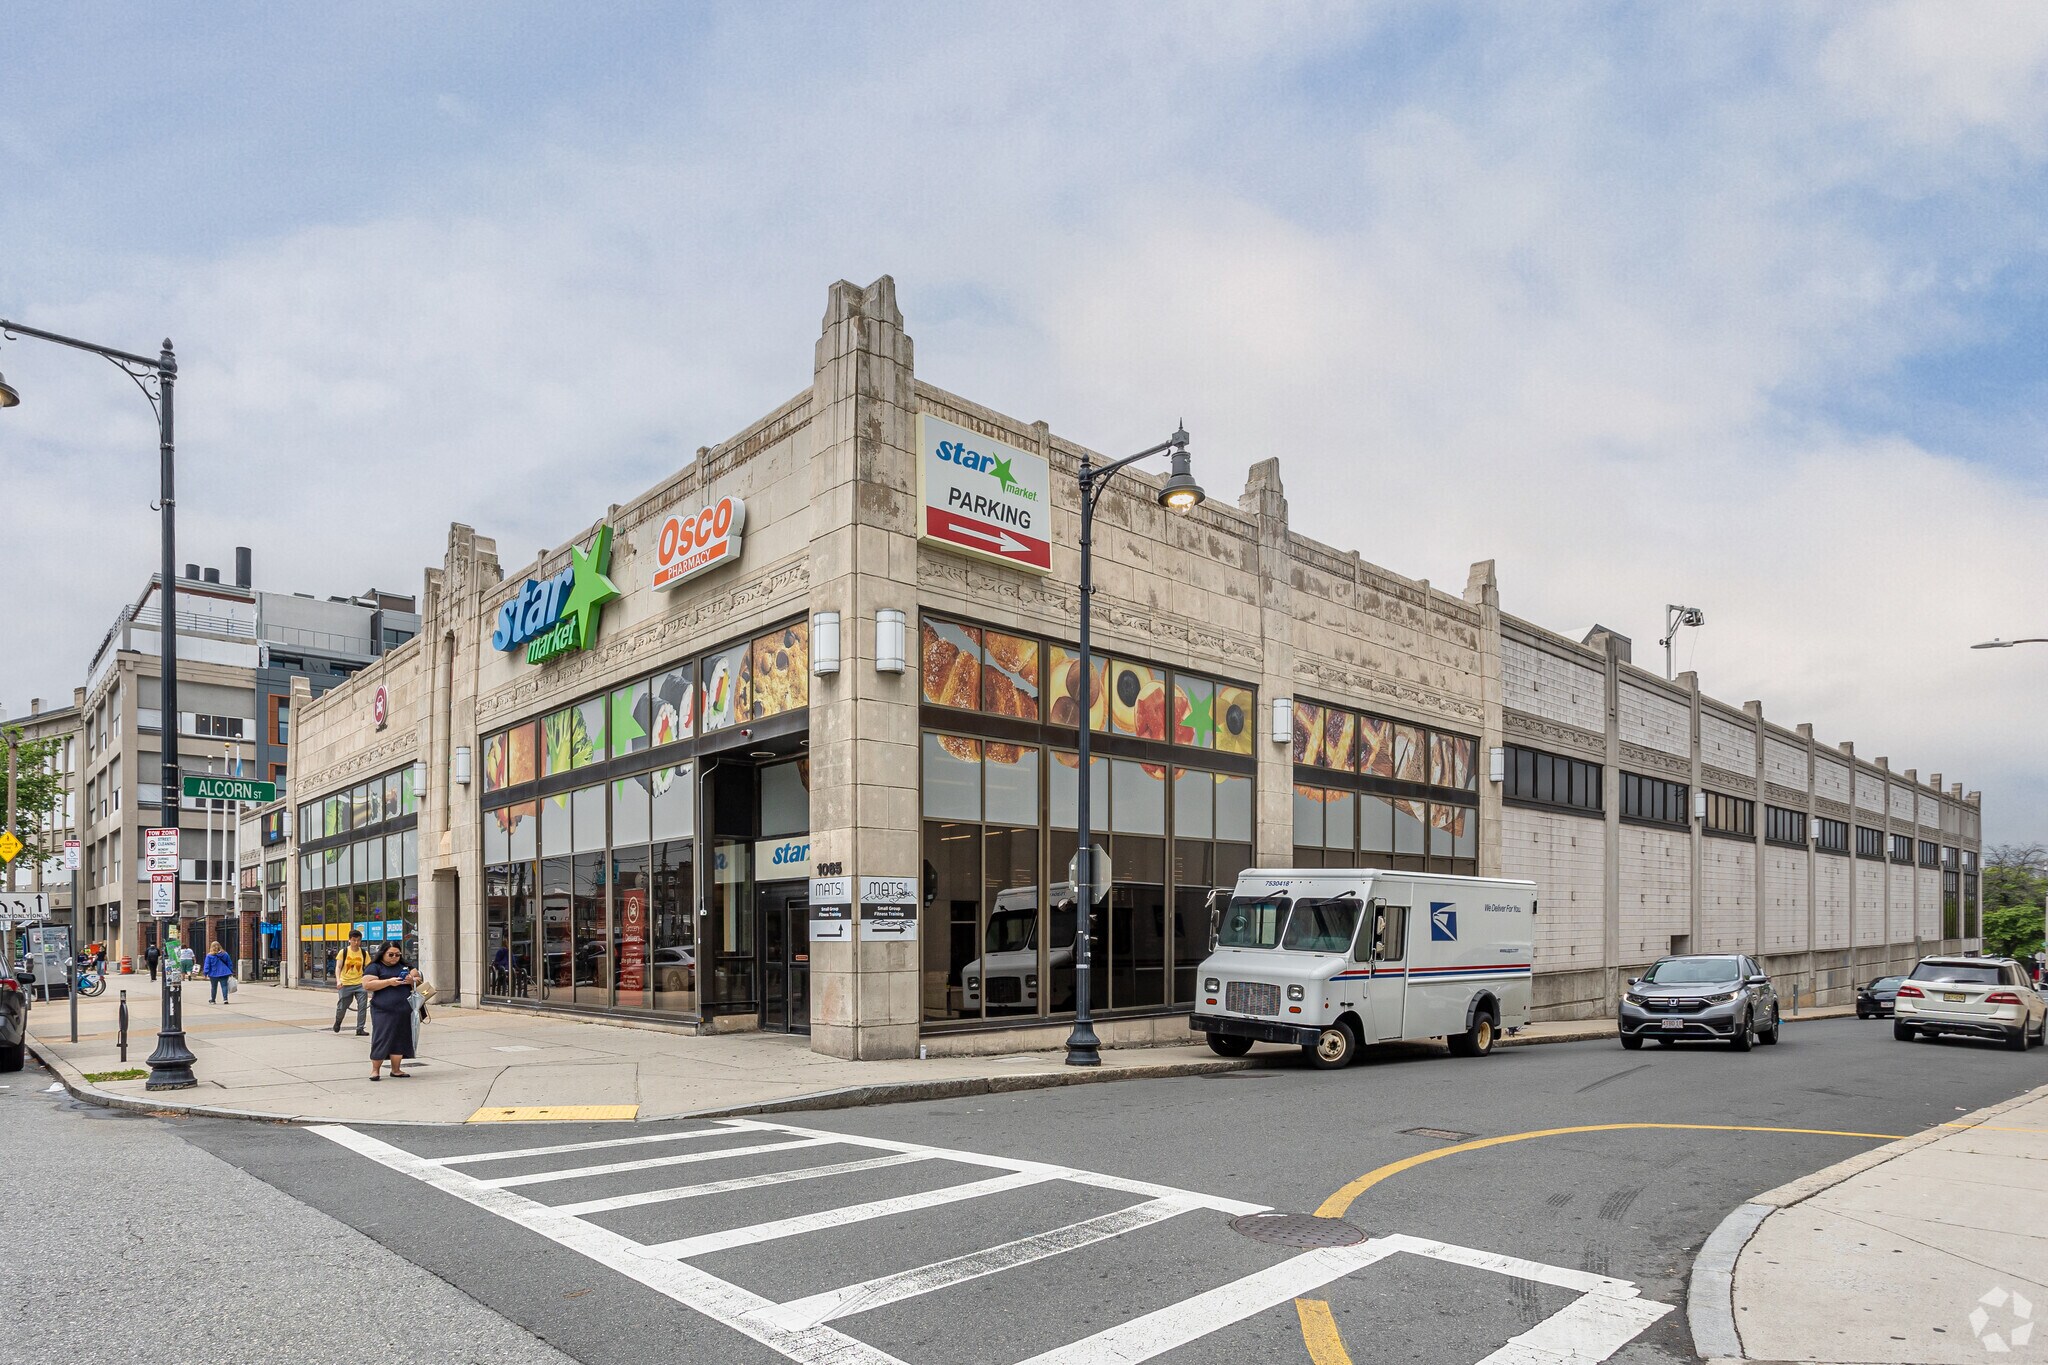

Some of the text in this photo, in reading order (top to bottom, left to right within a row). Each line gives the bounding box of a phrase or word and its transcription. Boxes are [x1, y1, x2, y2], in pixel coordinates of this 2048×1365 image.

[935, 440, 994, 473] star
[1006, 483, 1038, 502] market
[948, 486, 1031, 529] PARKING
[668, 549, 711, 579] PHARMACY
[493, 567, 575, 652] star
[526, 616, 579, 665] market
[198, 780, 262, 800] ALCORN ST
[772, 843, 810, 865] star
[816, 882, 841, 896] MATS
[1484, 904, 1492, 912] We
[1492, 904, 1506, 912] Deliver
[1506, 904, 1514, 913] For
